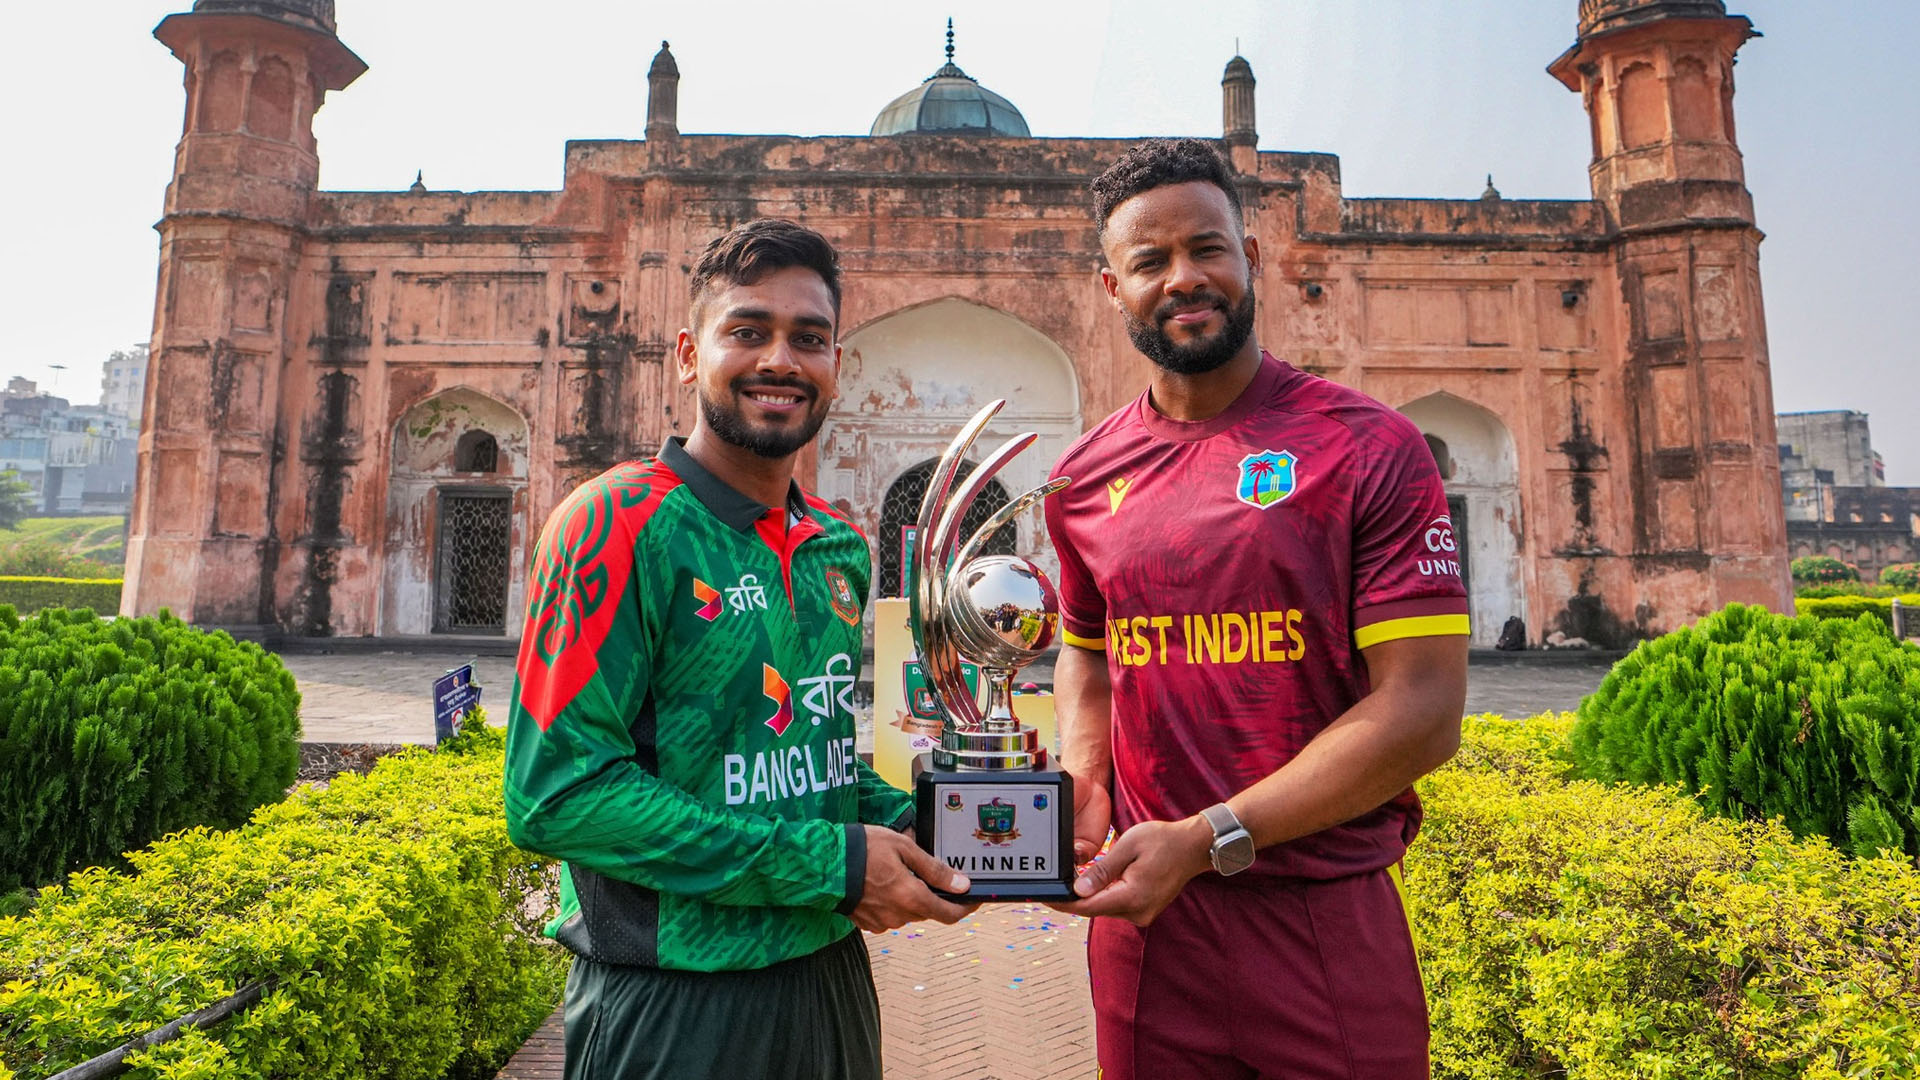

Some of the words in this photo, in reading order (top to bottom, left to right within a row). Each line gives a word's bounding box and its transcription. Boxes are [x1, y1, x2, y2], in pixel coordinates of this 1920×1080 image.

[1425, 527, 1456, 552] CG
[1418, 559, 1461, 577] UNIT
[725, 574, 768, 616] রবি
[1184, 609, 1306, 665] INDIES
[947, 856, 1046, 871] WINNER
